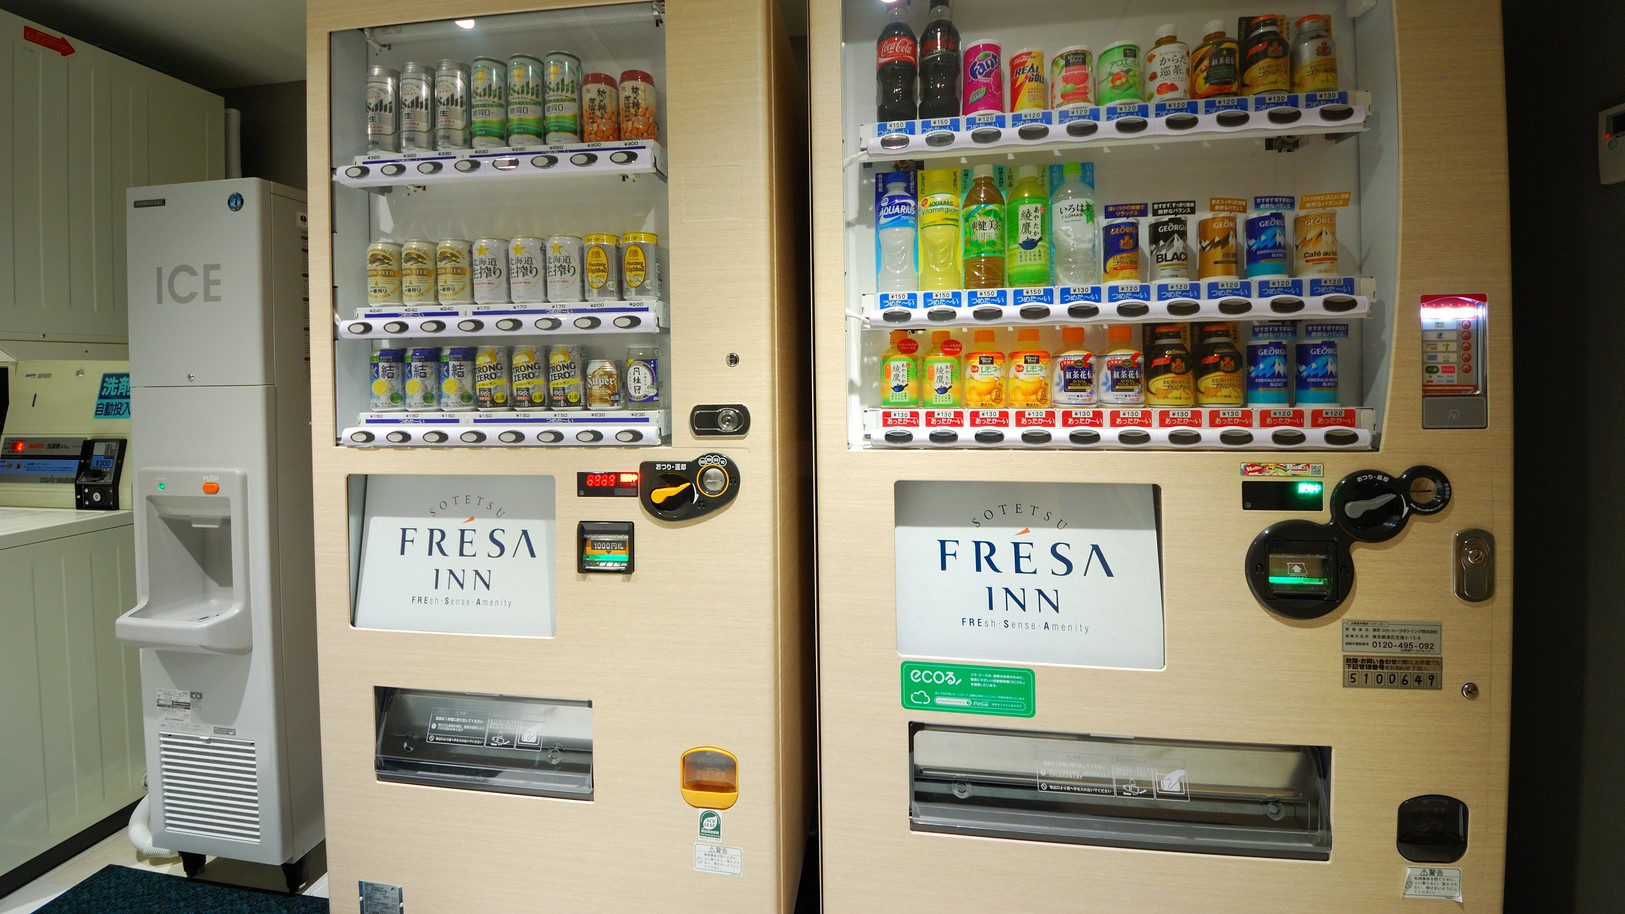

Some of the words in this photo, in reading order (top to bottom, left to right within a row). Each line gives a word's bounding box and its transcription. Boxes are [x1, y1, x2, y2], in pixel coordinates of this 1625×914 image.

[1160, 56, 1187, 66] からだ
[1014, 64, 1040, 78] REAL
[879, 204, 916, 217] AQUARIUS
[971, 218, 1001, 231] 爽健美茶
[1020, 209, 1032, 235] 綾鷹
[156, 264, 222, 304] ICE
[476, 373, 497, 382] ZERO
[513, 372, 535, 381] ZERO
[550, 372, 570, 381] ZERO
[95, 404, 130, 416] 自動投入
[430, 495, 506, 518] SOTETSU
[972, 503, 1068, 530] SOTETSU
[434, 568, 491, 591] INN
[986, 586, 1060, 614] INN
[1372, 641, 1434, 650] 0120-495-092
